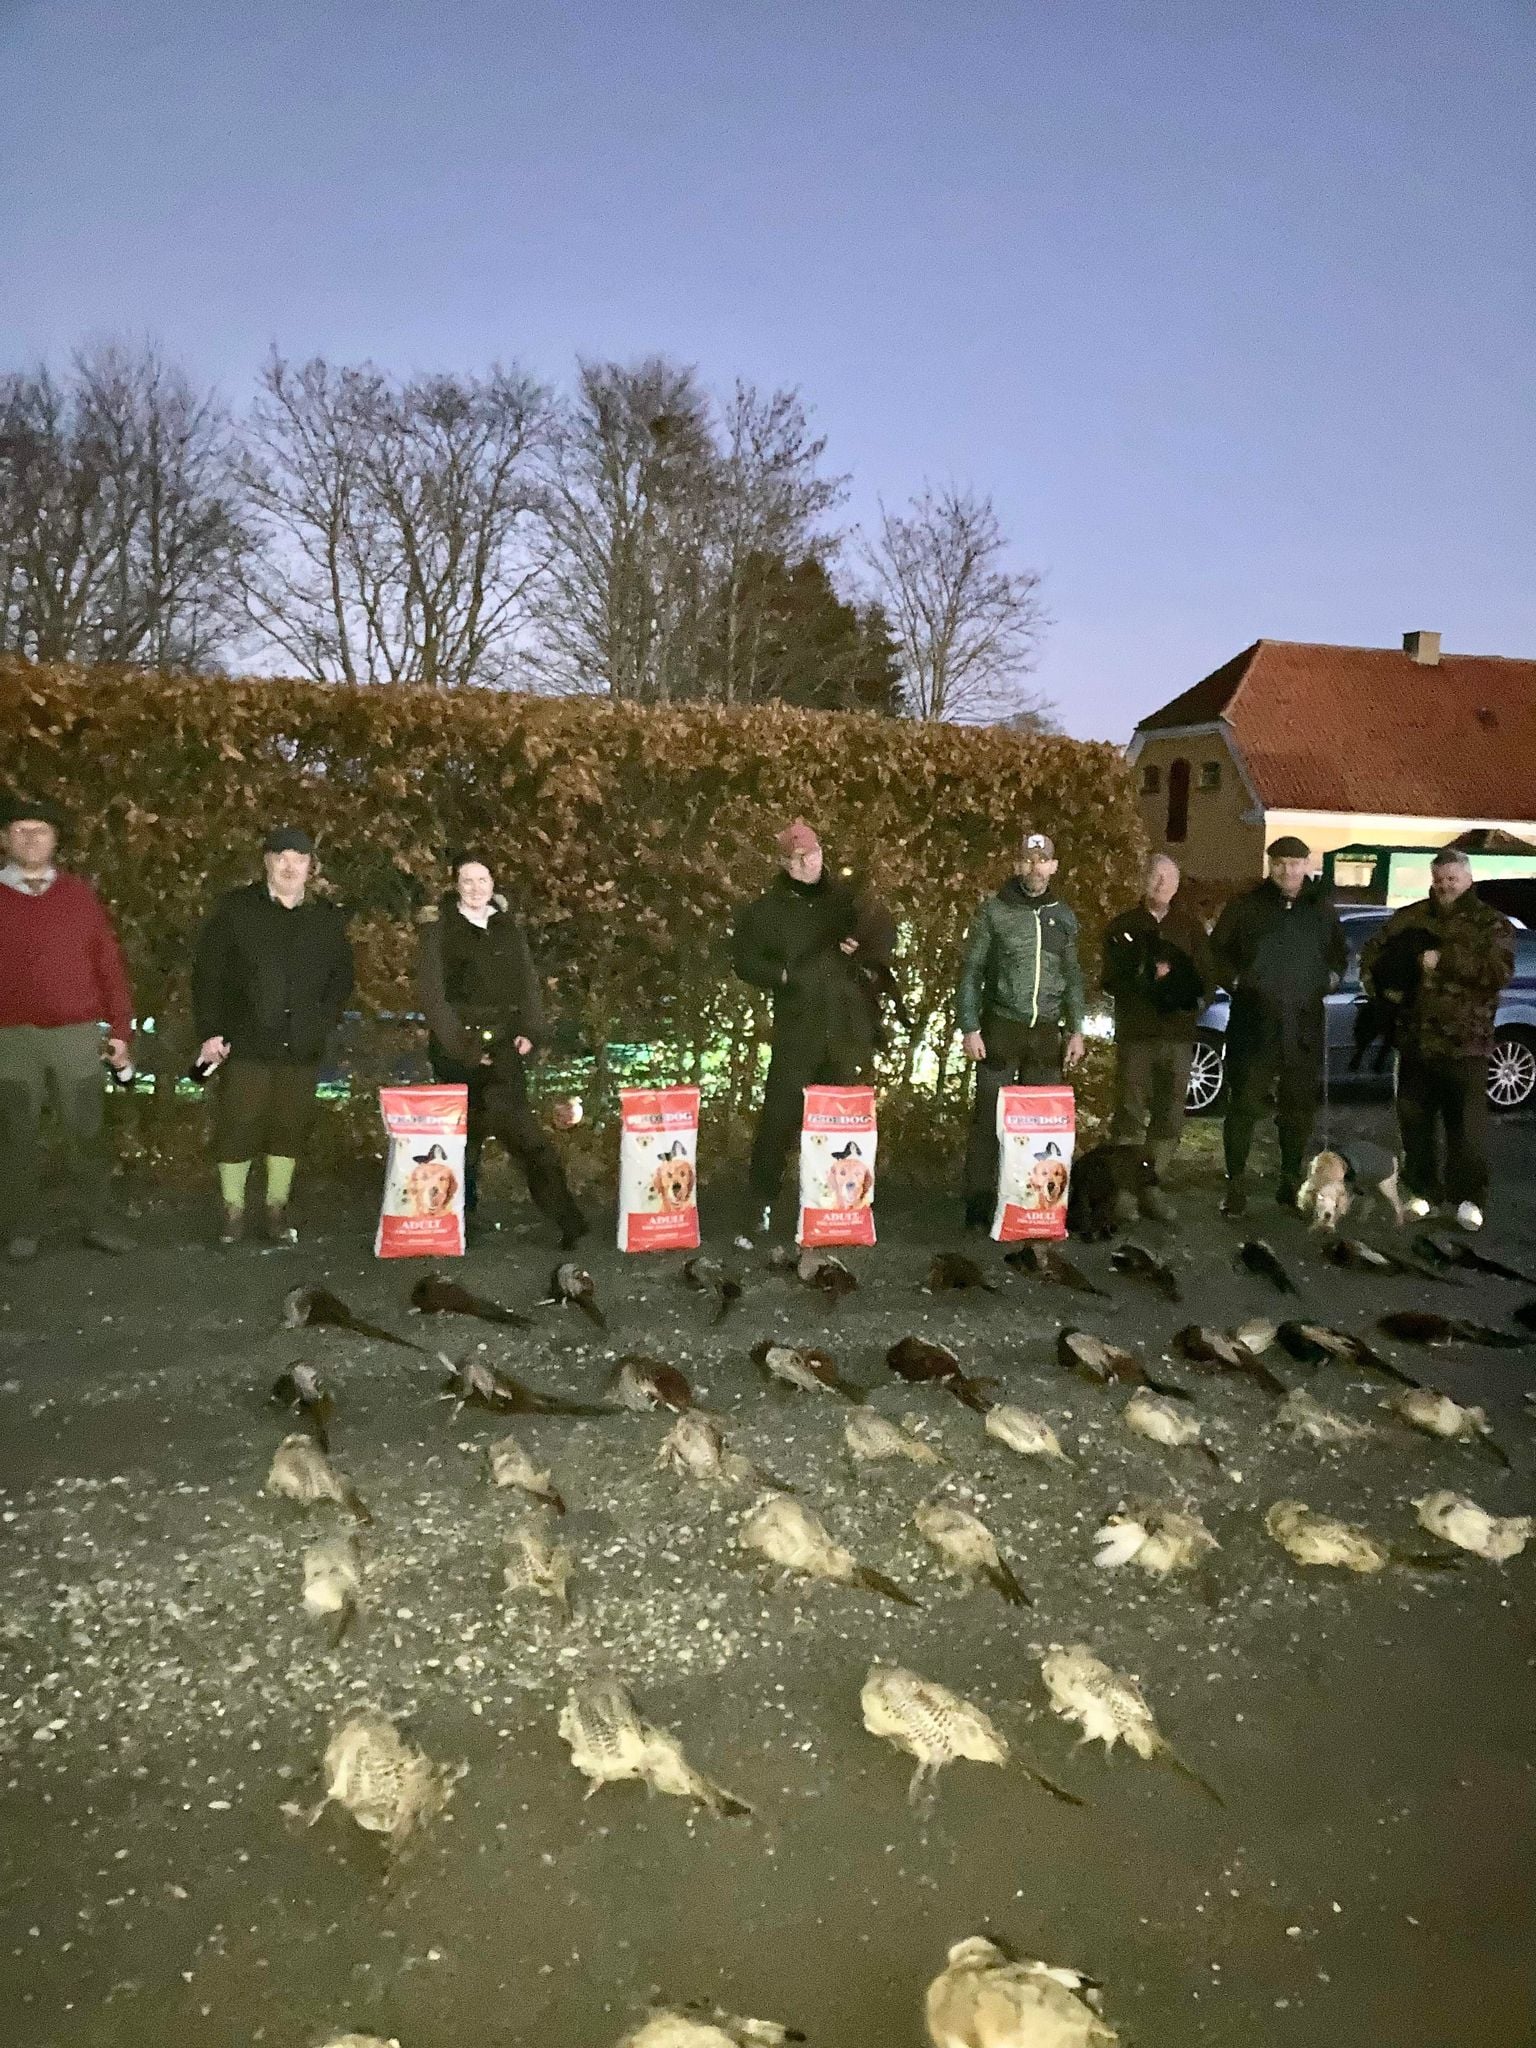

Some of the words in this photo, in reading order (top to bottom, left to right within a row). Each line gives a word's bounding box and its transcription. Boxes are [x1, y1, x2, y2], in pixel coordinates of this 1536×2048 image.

[650, 1214, 685, 1225] ADULT
[822, 1212, 861, 1222] ADULT
[1025, 1212, 1056, 1220] ADULT
[401, 1220, 442, 1230] ADULT
